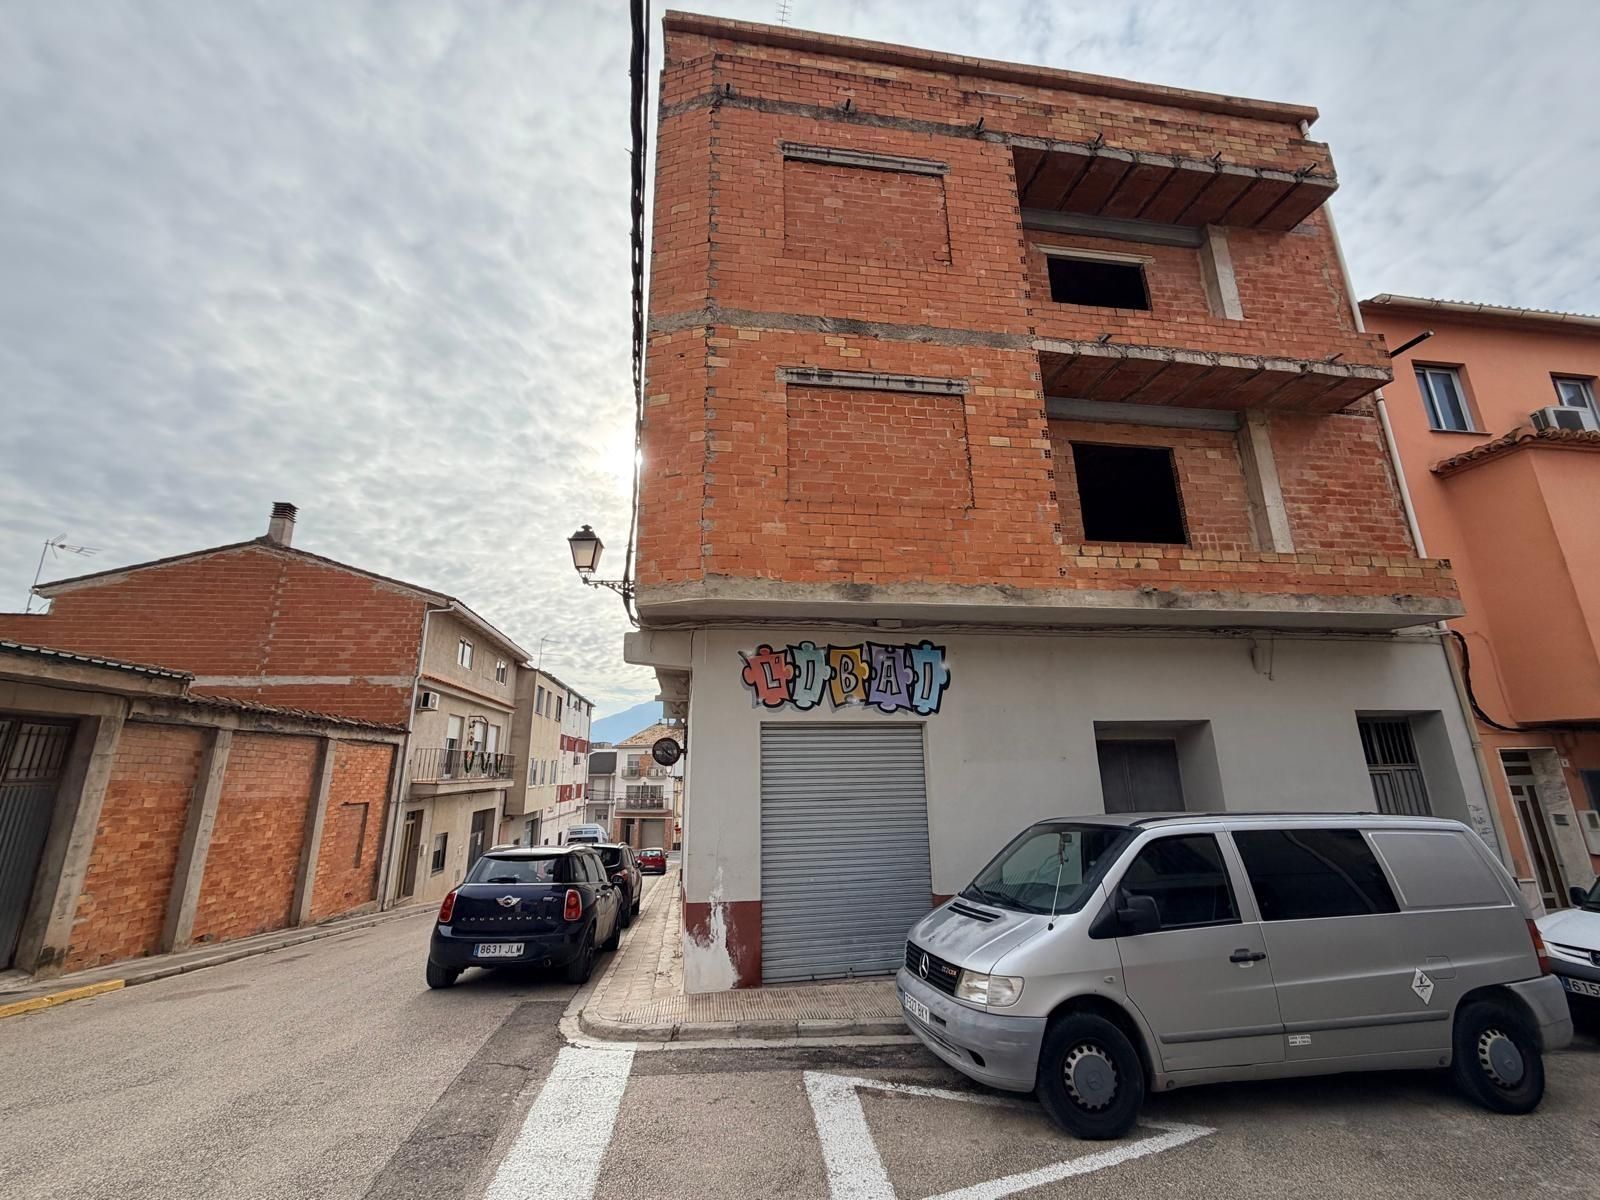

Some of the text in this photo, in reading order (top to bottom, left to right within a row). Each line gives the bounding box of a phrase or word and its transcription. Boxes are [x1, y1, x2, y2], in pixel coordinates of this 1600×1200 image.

[480, 944, 522, 954] 8631 JLM
[1572, 981, 1600, 995] 615
